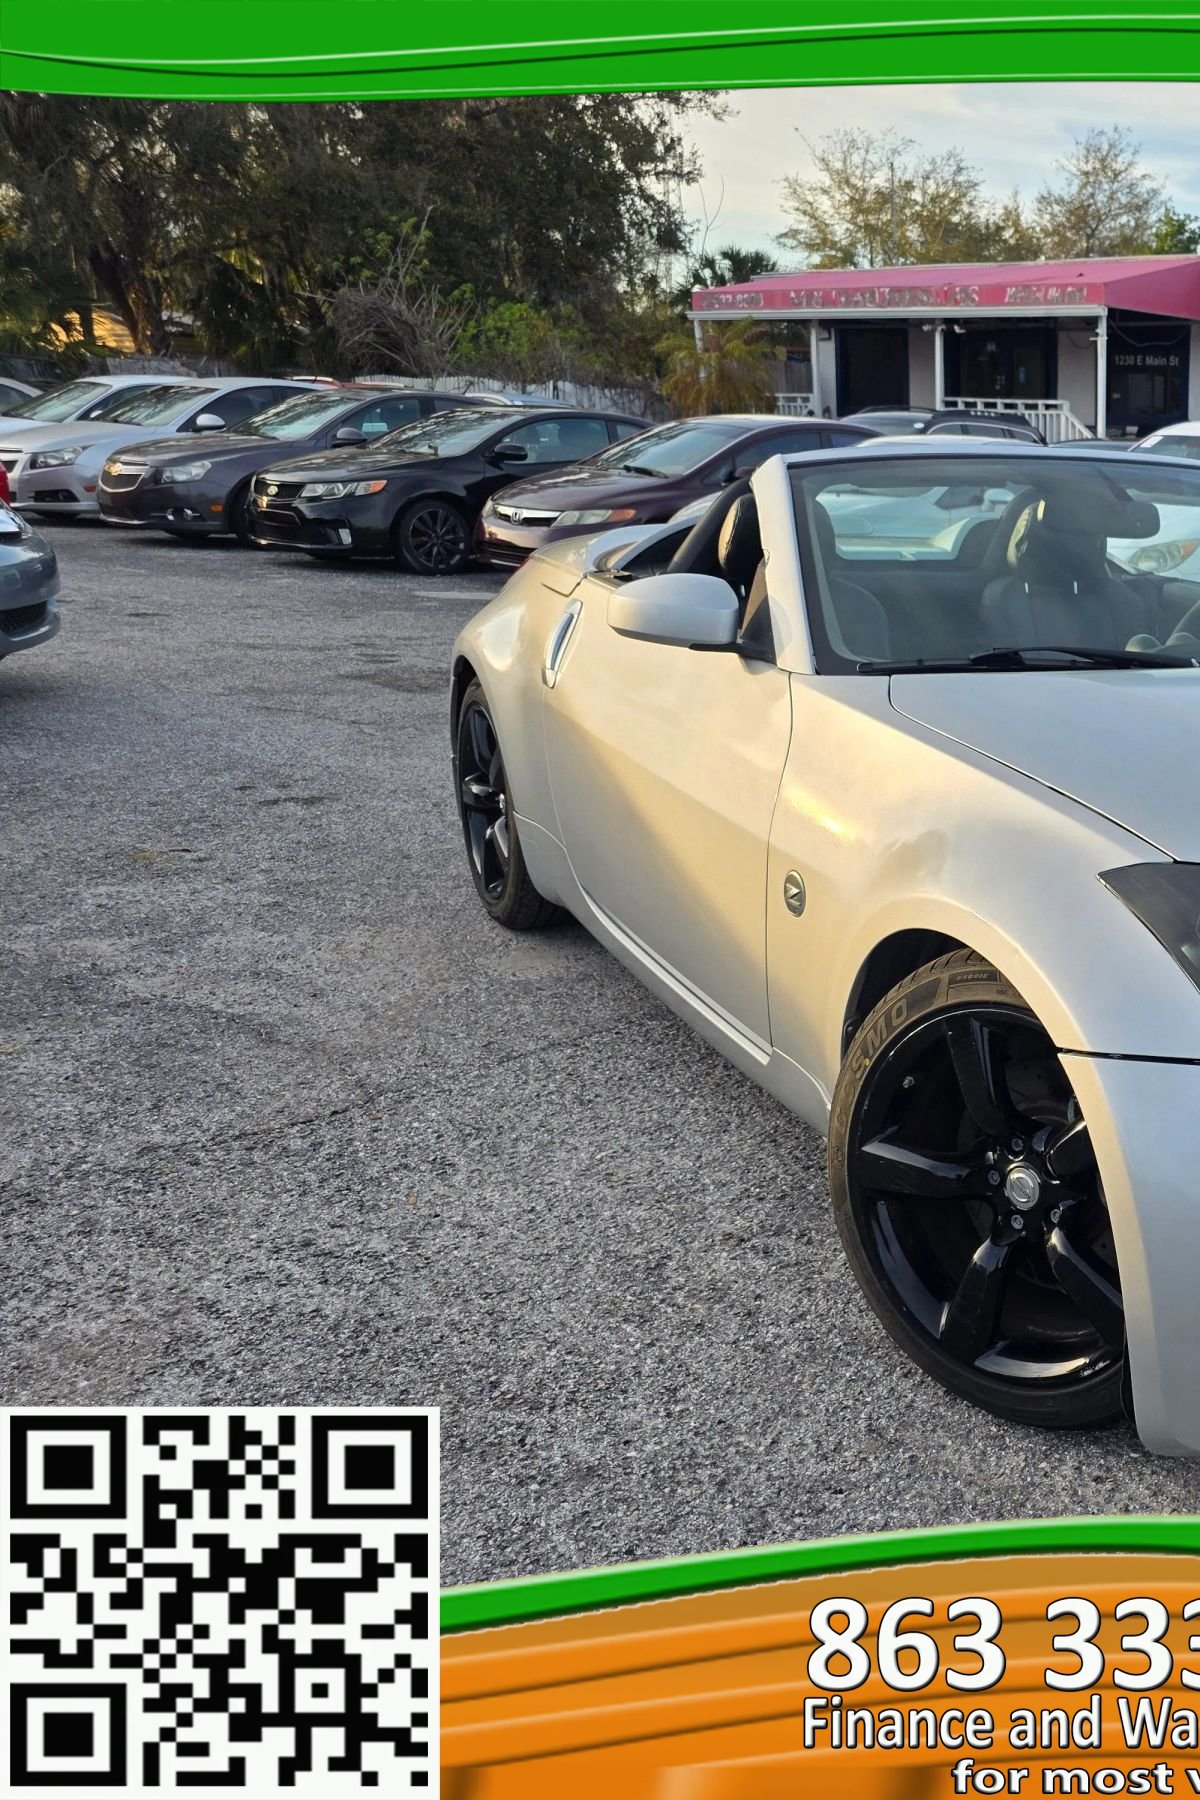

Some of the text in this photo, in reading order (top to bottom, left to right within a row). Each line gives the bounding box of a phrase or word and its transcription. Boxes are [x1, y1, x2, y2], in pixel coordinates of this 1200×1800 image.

[1115, 355, 1135, 366] 1230
[1137, 355, 1144, 366] E
[1145, 356, 1167, 366] Main
